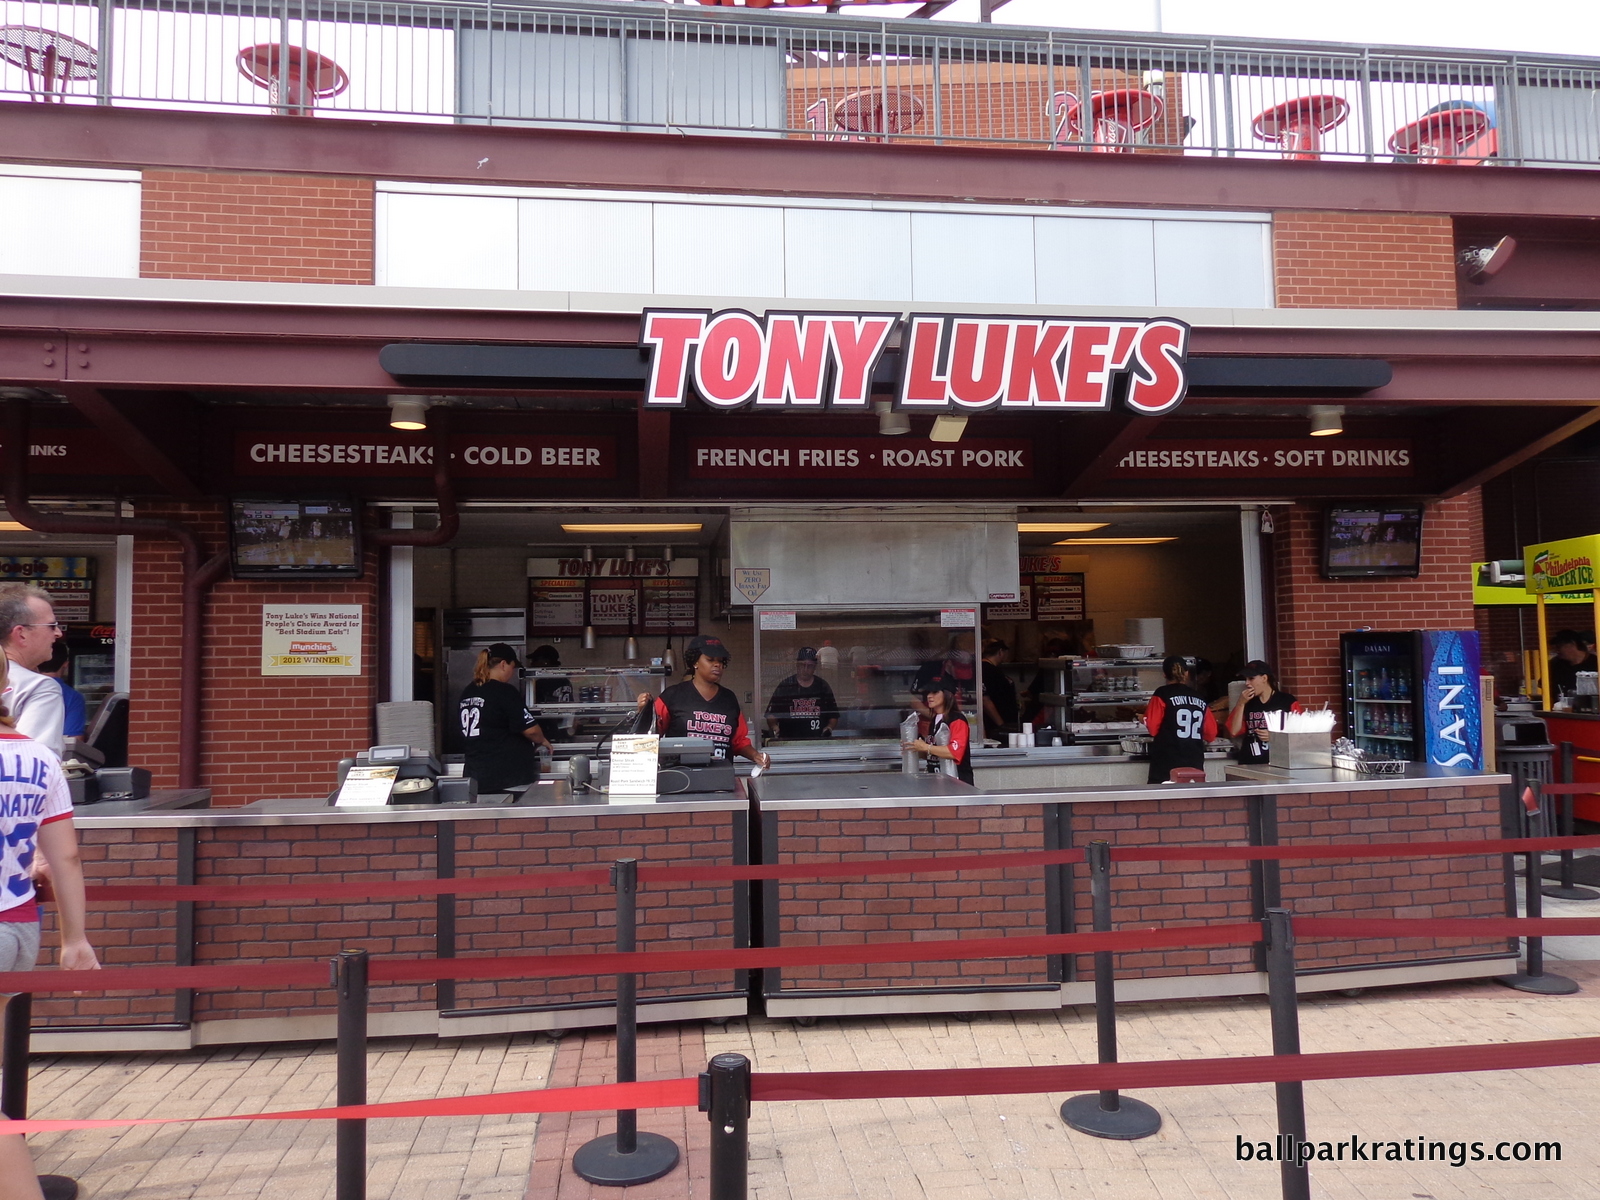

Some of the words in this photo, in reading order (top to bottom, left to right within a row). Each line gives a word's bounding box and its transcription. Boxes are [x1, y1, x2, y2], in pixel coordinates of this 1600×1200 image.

[643, 311, 897, 406] TONY
[900, 316, 1186, 412] LUKE'S
[464, 446, 533, 465] COLD
[541, 447, 601, 466] BEER
[697, 448, 790, 467] FRENCH
[799, 449, 860, 467] FRIES
[882, 449, 955, 467] ROAST
[962, 450, 1024, 467] PORK
[1116, 450, 1259, 468] HEESESTEAKS
[1274, 450, 1325, 467] SOFT
[1332, 450, 1410, 466] DRINKS
[1545, 557, 1591, 577] Philadelphia
[1546, 569, 1577, 588] WATER
[1577, 565, 1594, 584] ICE
[39, 581, 83, 589] Beverages
[591, 594, 624, 603] TONY
[265, 612, 283, 620] Tony
[593, 604, 637, 613] LUKE'S
[292, 643, 331, 651] munchies
[1364, 645, 1391, 653] DASANI
[1170, 695, 1187, 706] TONY
[460, 707, 480, 737] 92
[693, 710, 727, 723] TONY
[810, 719, 820, 730] 92
[1176, 708, 1203, 740] 92
[687, 719, 732, 735] LUKE'S
[0, 821, 39, 898] 3
